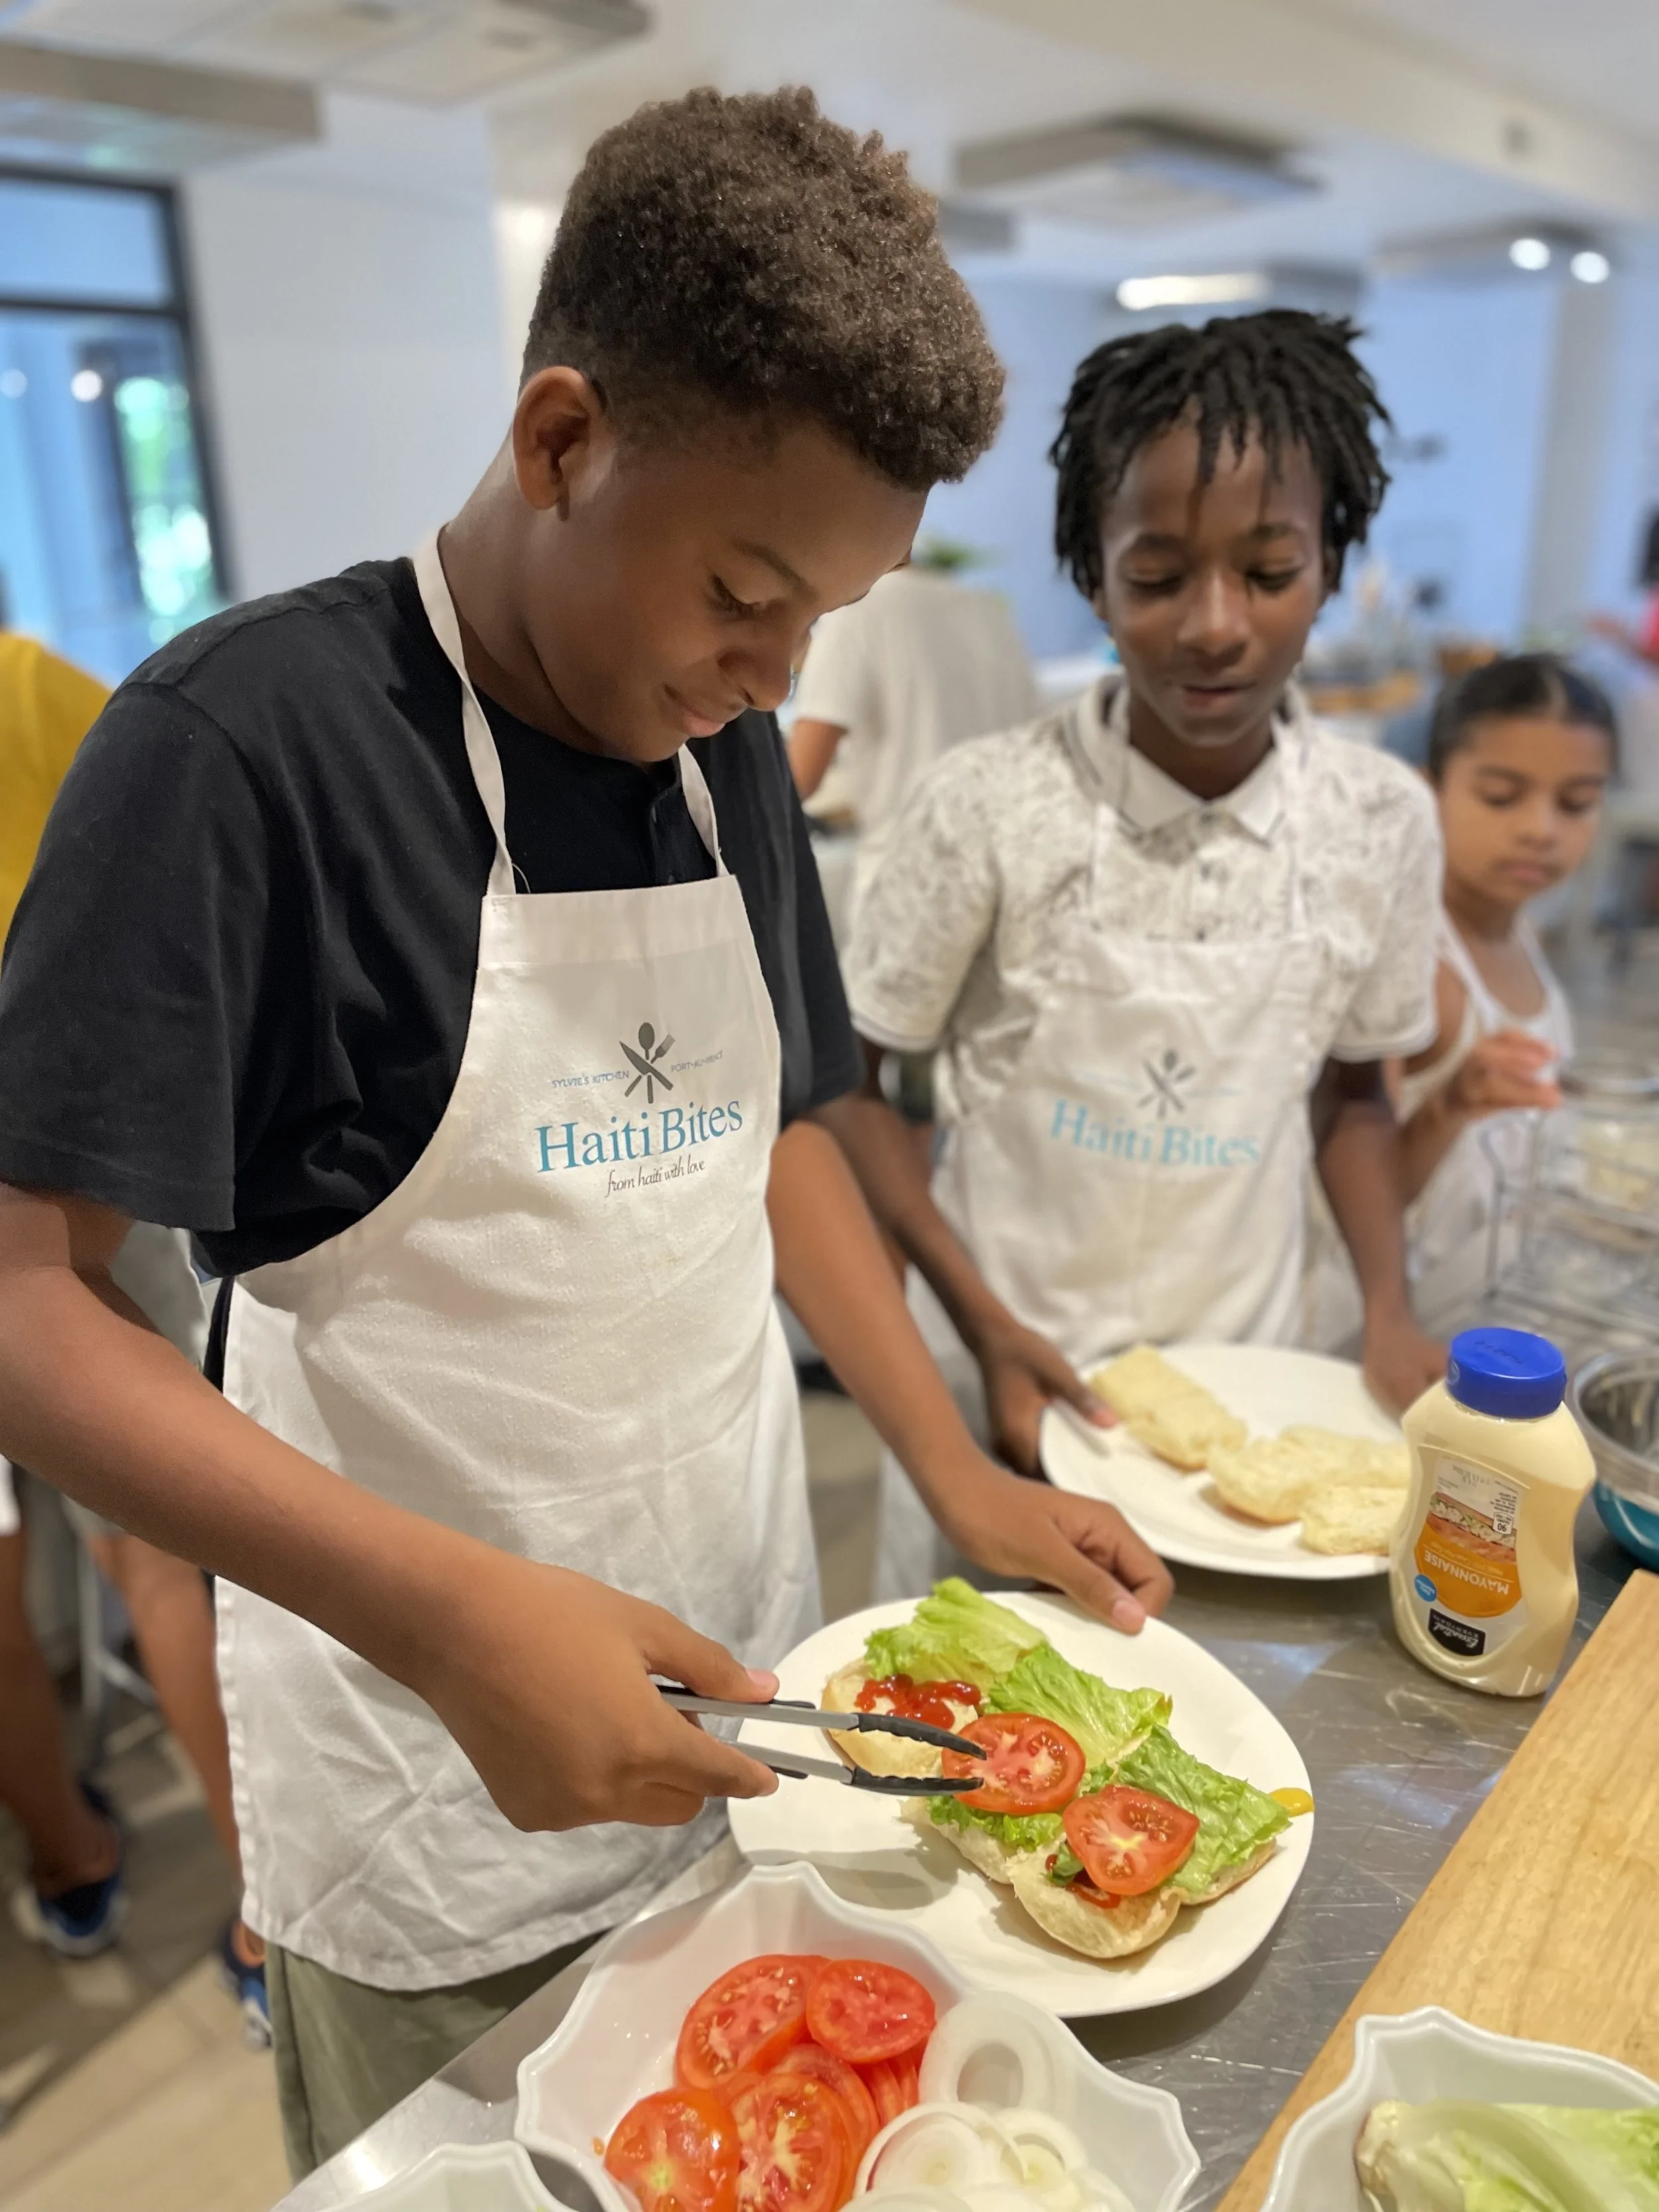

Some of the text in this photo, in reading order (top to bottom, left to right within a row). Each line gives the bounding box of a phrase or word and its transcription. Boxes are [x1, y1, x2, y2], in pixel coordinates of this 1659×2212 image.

[552, 1072, 589, 1088] SYLVIE'S
[592, 1070, 630, 1084] KITCHEN
[534, 1100, 743, 1173] Haiti Bites
[1049, 1098, 1153, 1161] Haiti
[605, 1153, 706, 1199] from haiti with love
[1497, 1523, 1507, 1532] 90
[1424, 1549, 1510, 1595] MAYONNAISE
[1433, 1621, 1479, 1649] Essential
